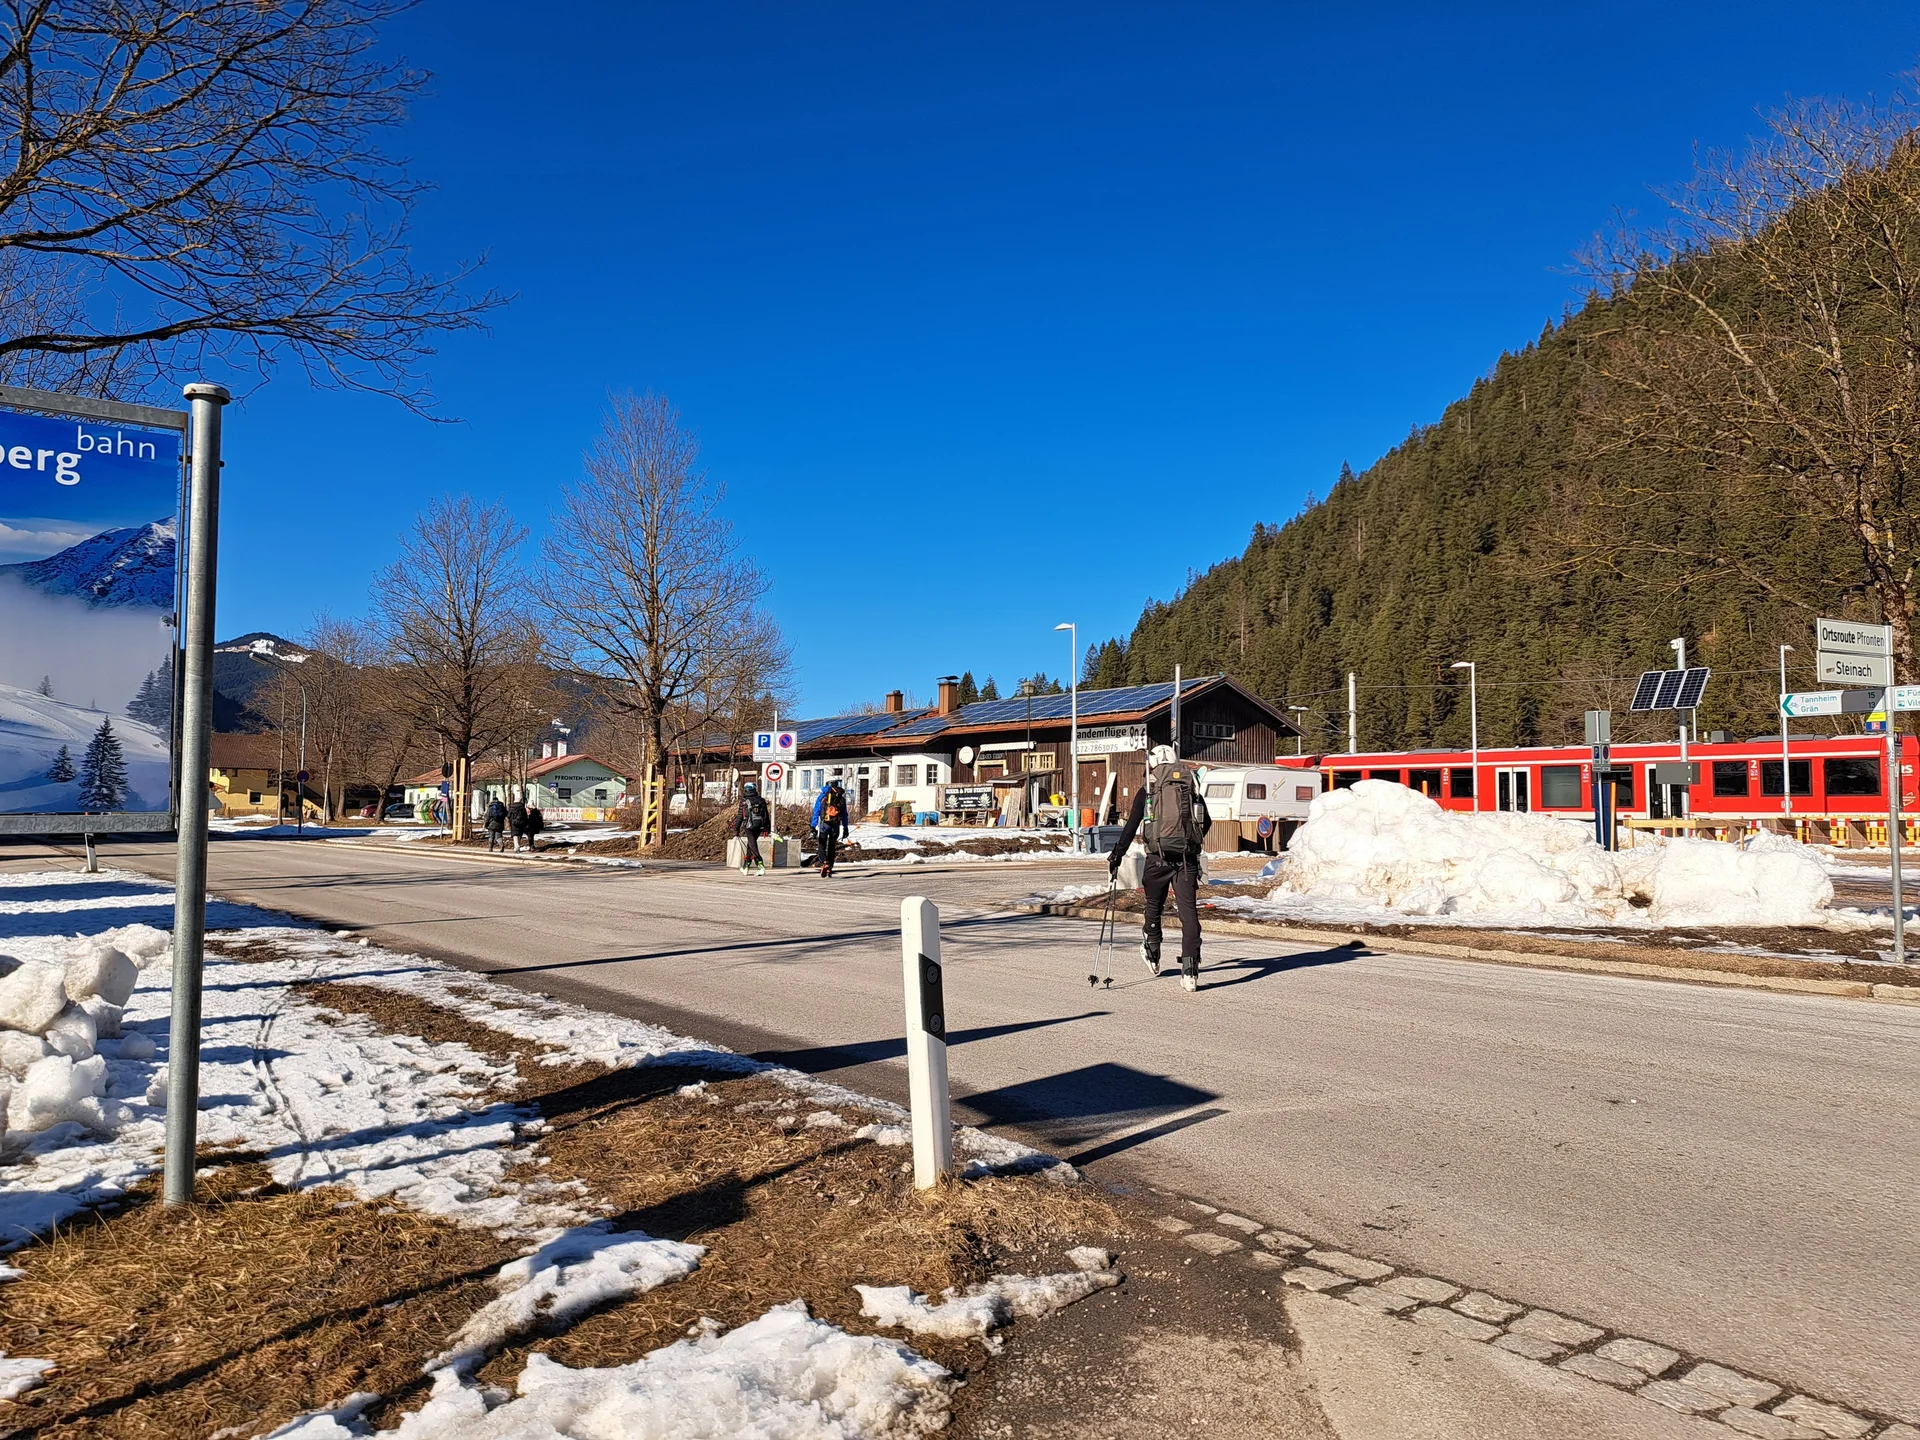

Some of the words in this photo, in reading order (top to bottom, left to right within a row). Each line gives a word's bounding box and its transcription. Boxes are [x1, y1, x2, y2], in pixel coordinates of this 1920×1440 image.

[0, 444, 82, 486] erg
[77, 425, 156, 460] bahn
[1822, 627, 1856, 644] Ortsroute
[1856, 631, 1885, 647] Pfronten
[1836, 661, 1872, 677] Steinach
[1800, 695, 1837, 703] Tannheim
[1868, 691, 1876, 699] 15
[1801, 705, 1819, 713] Grän
[1868, 701, 1876, 709] 13
[1077, 727, 1127, 739] andemflüge
[1077, 743, 1118, 753] 172-7863075
[1751, 759, 1757, 768] 2
